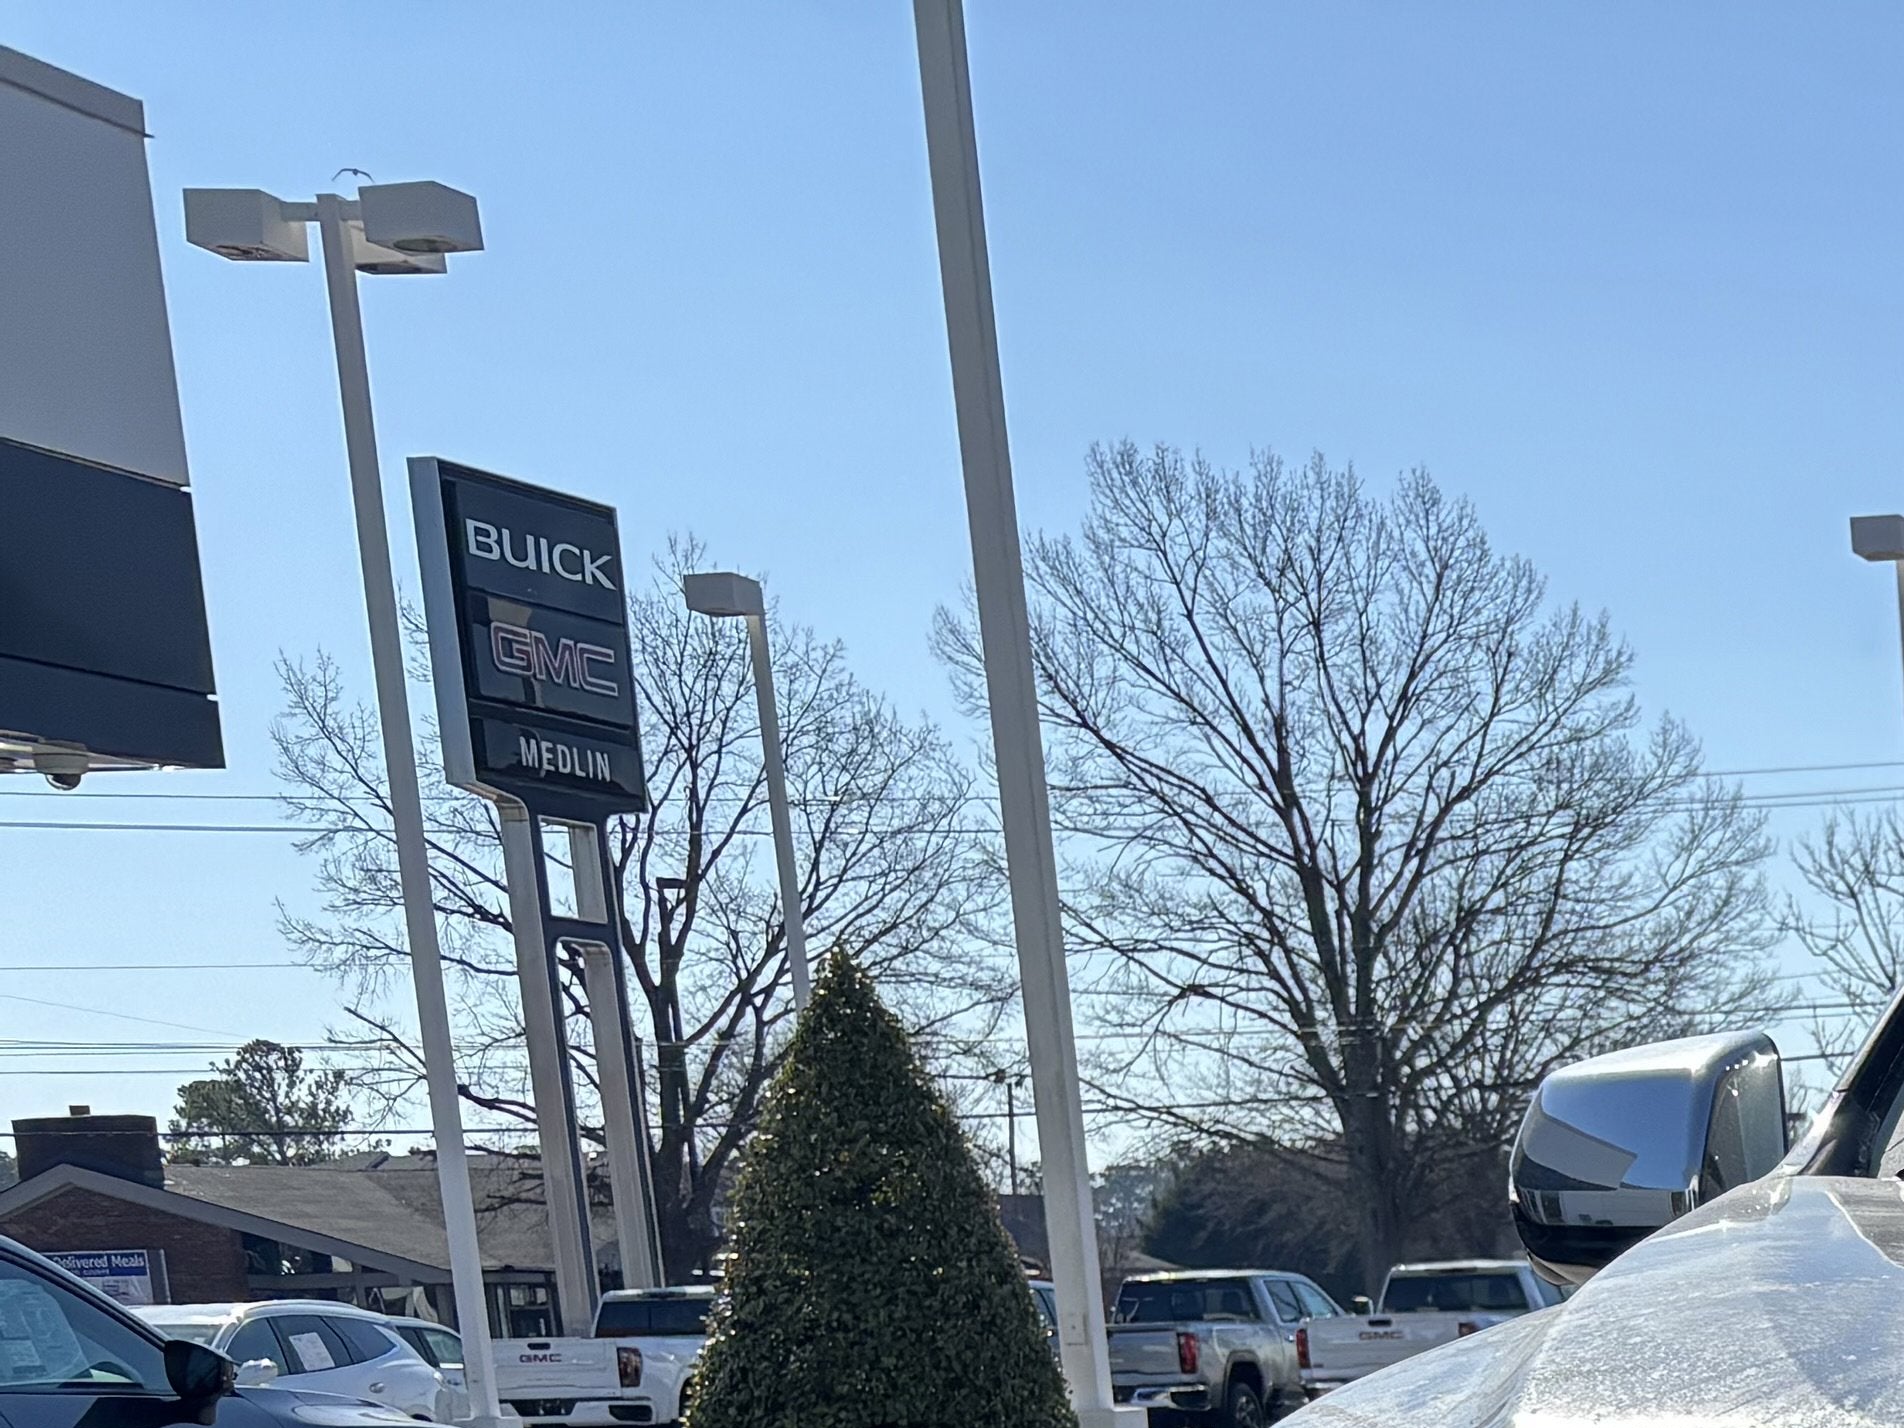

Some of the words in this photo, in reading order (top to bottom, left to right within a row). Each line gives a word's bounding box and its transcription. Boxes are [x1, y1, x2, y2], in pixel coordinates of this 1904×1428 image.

[466, 518, 617, 591] BUICK
[490, 621, 619, 697] GMC
[519, 735, 612, 783] MEDLIN
[111, 1254, 145, 1268] Meals
[1358, 1331, 1404, 1341] GMC
[519, 1353, 562, 1363] GMC
